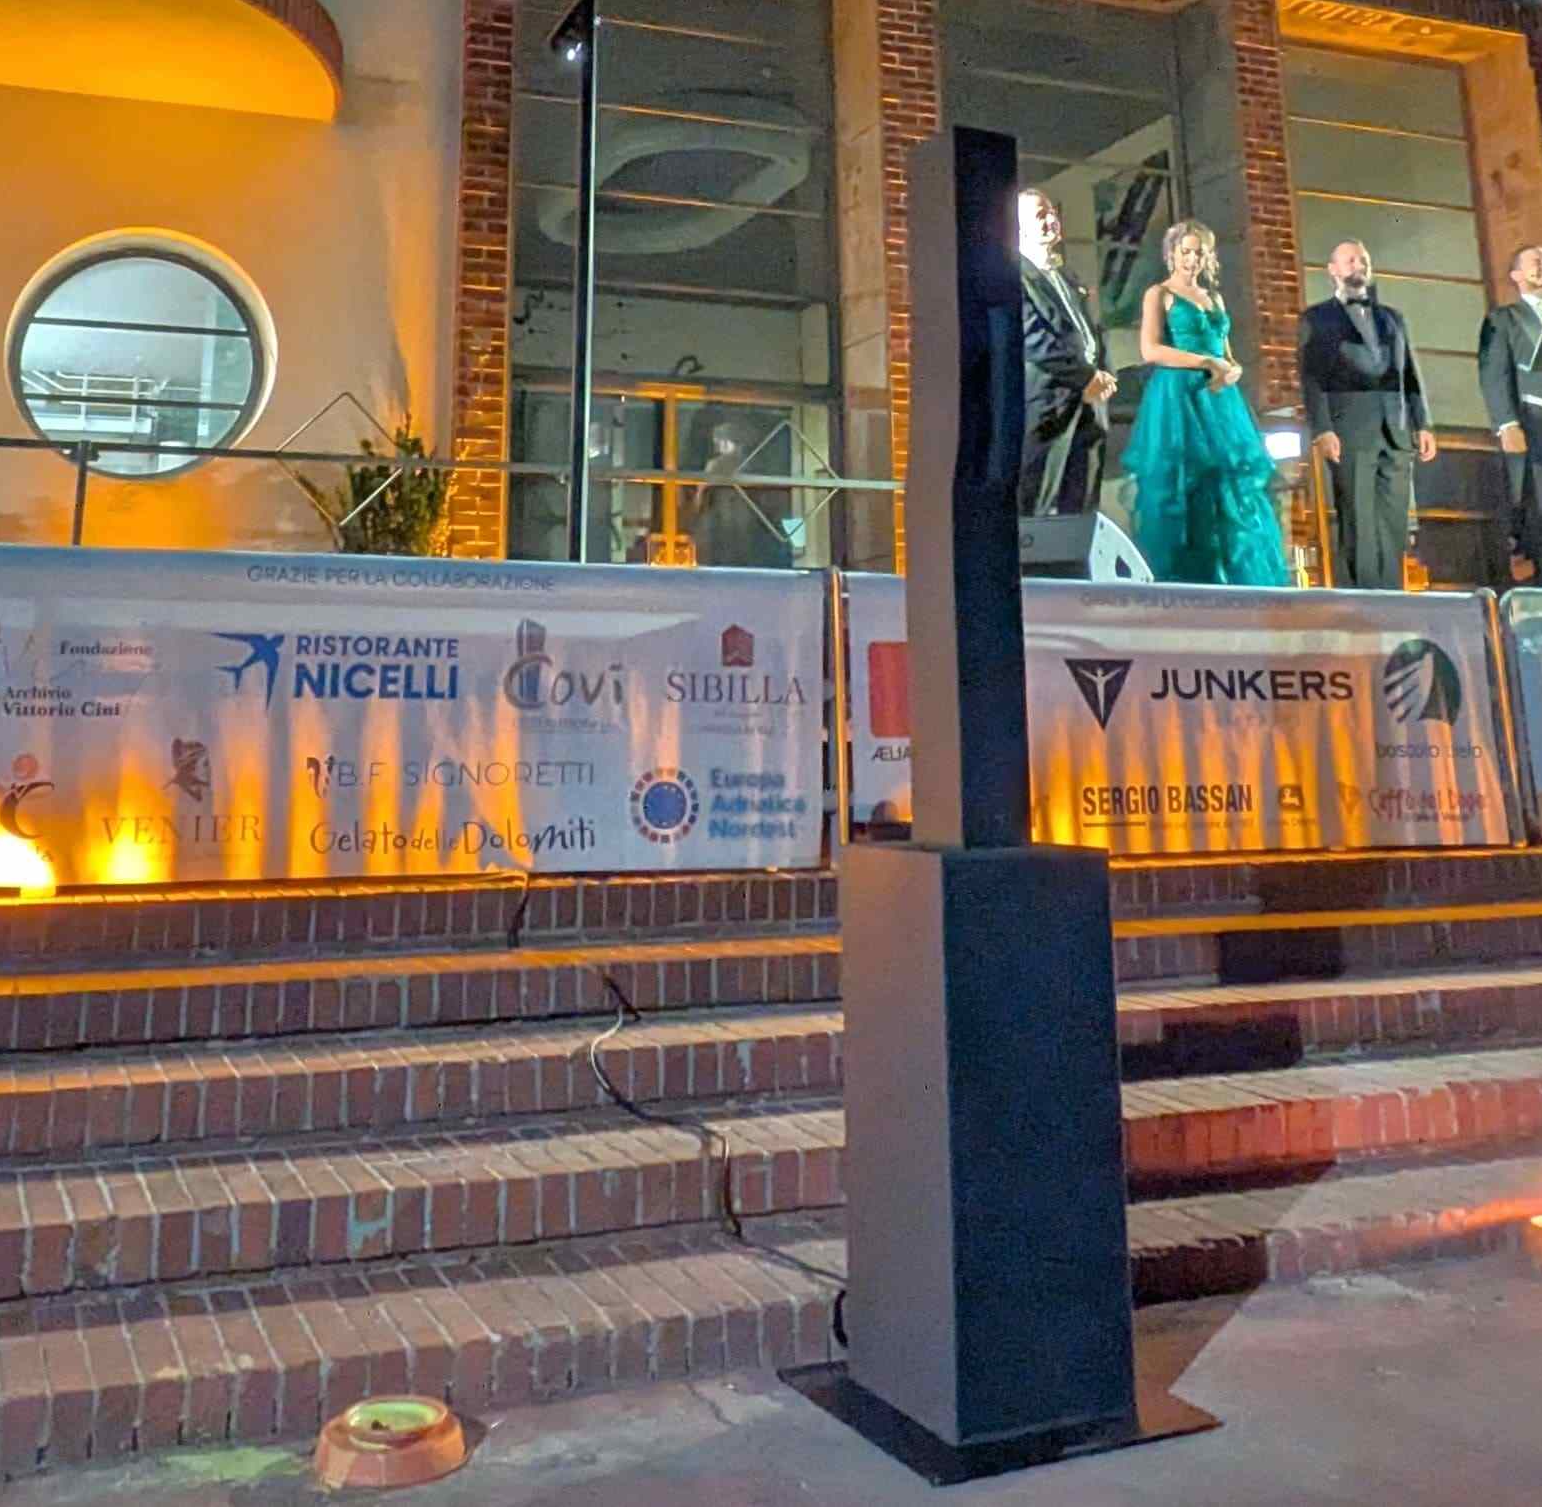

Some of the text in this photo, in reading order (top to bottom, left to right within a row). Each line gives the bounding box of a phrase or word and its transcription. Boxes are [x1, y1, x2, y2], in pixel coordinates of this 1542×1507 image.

[247, 565, 317, 583] GRAZIE
[324, 566, 360, 585] PER
[295, 635, 459, 658] RISTORANTE
[293, 663, 459, 700] NICELLI
[666, 670, 808, 705] SIBILLA
[1150, 669, 1354, 701] JUNKERS
[3, 701, 121, 717] Vittorio Cini
[403, 759, 595, 787] SIGNORETTI
[1082, 784, 1253, 816] SERGIO BASSAN
[102, 814, 262, 845] VENIER
[309, 821, 408, 855] Gelato
[462, 817, 596, 855] Dolomiti
